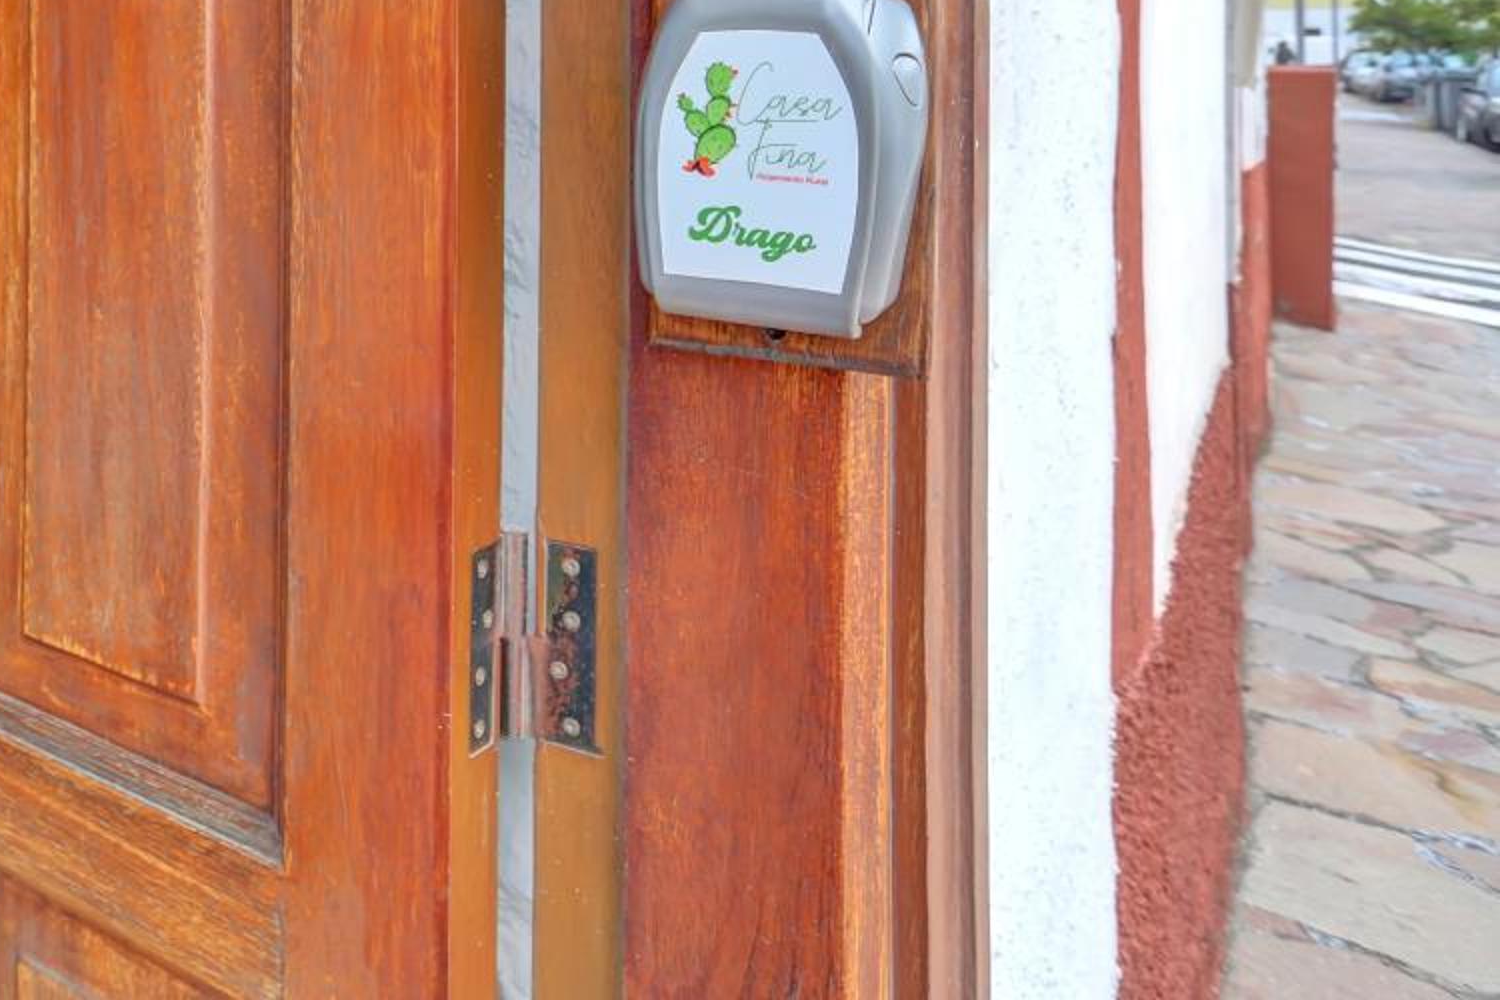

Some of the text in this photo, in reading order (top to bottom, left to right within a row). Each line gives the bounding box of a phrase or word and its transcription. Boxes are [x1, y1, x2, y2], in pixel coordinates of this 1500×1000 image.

[737, 61, 842, 126] Casa
[747, 119, 826, 180] Fina
[688, 205, 816, 262] Drago
